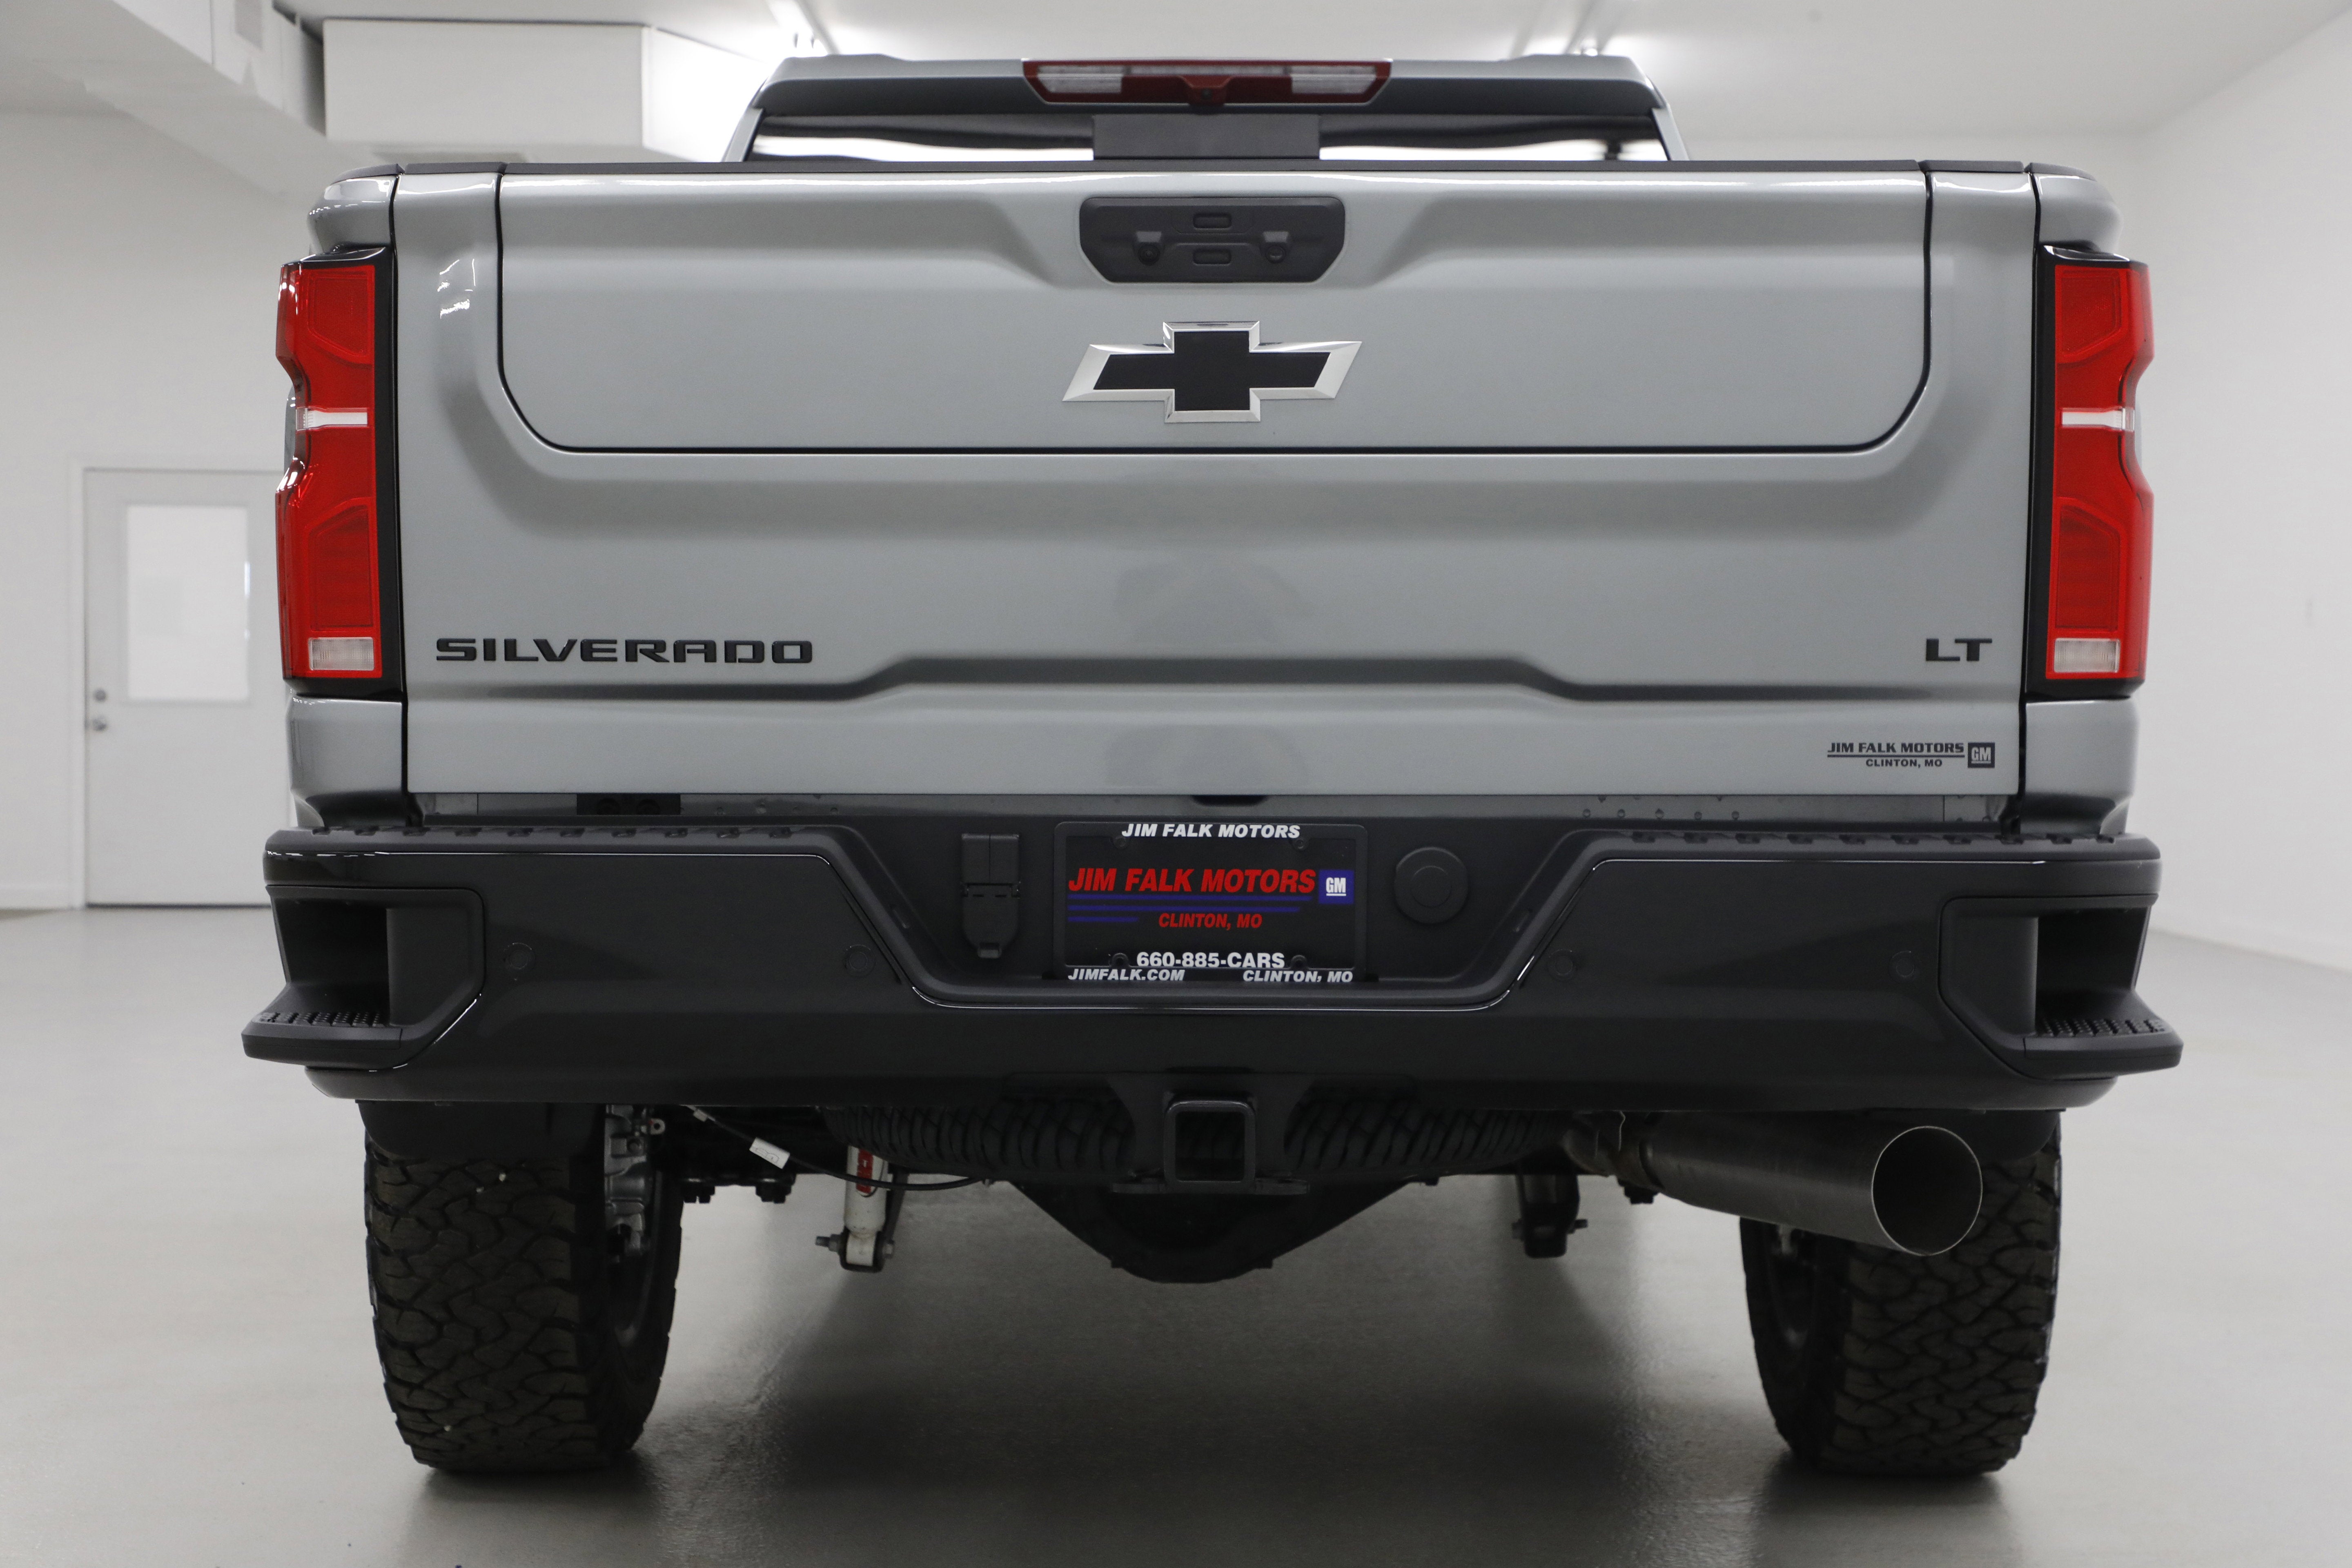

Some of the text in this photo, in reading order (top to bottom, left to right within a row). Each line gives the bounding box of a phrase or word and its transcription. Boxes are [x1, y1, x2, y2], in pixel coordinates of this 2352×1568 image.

[436, 638, 813, 664] SILVERADO
[1925, 638, 1993, 662] LT
[1827, 742, 1964, 753] JIM FALK MOTORS
[1971, 746, 1991, 761] GM
[1866, 759, 1942, 768] CLINTON, MO
[1121, 823, 1301, 838] JIM FALK MOTORS
[1068, 868, 1316, 893] JIM FALK MOTORS
[1326, 877, 1346, 893] GM
[1158, 913, 1263, 931] CLINTON, MO
[1137, 951, 1285, 969] 660-885-CARS
[1068, 969, 1185, 981] JIMFALK.COM
[1243, 970, 1353, 982] CLINTON, MO
